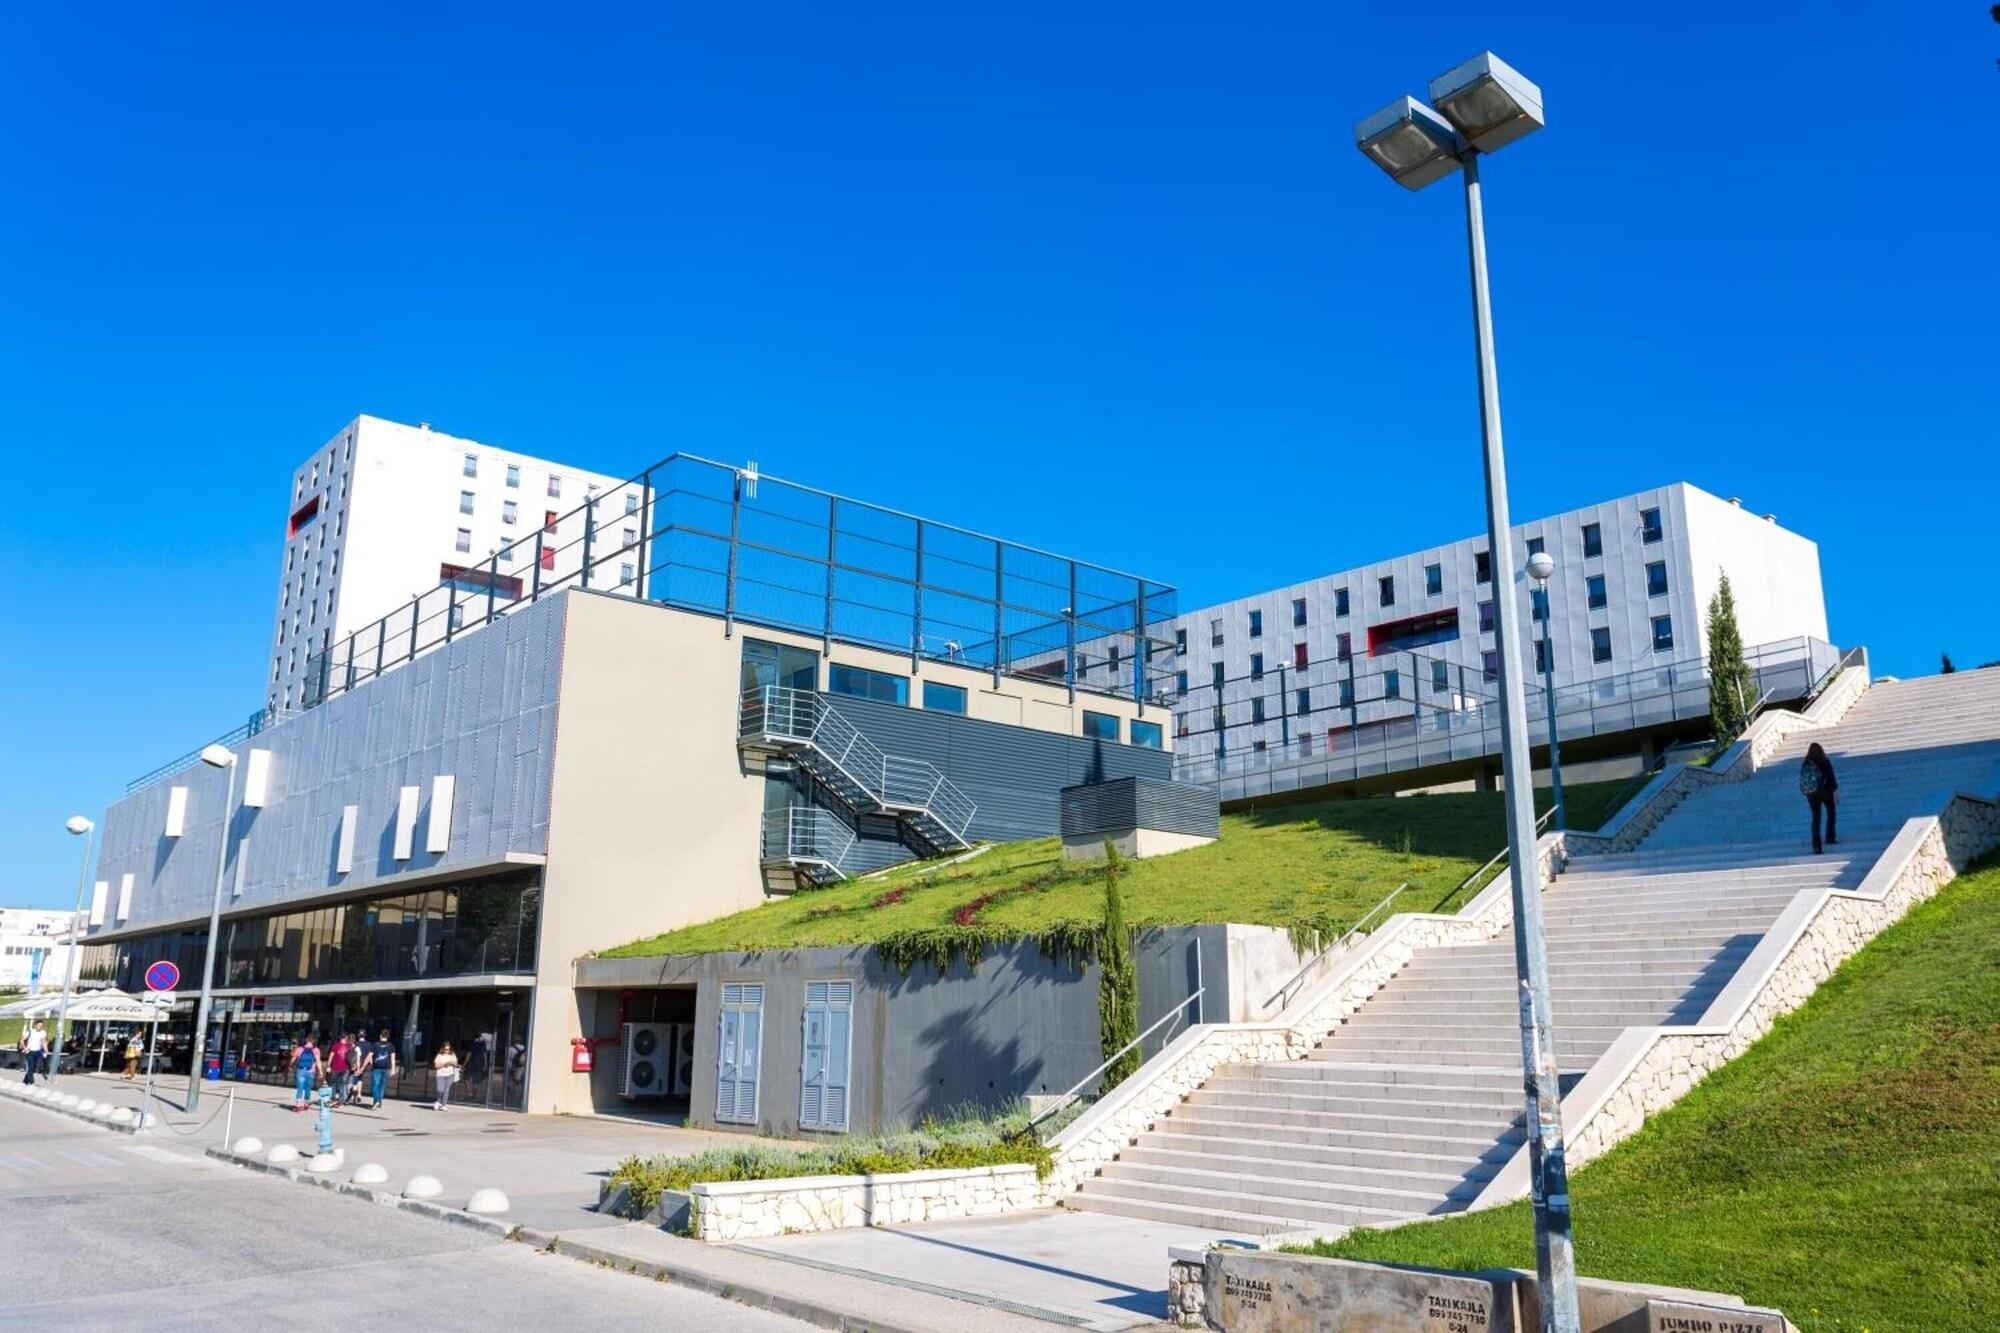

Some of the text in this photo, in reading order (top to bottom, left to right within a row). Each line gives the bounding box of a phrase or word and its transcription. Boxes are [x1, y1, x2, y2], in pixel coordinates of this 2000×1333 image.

[1428, 1295, 1486, 1315] TAXI KAJLA
[1660, 1317, 1713, 1332] JUMBO
